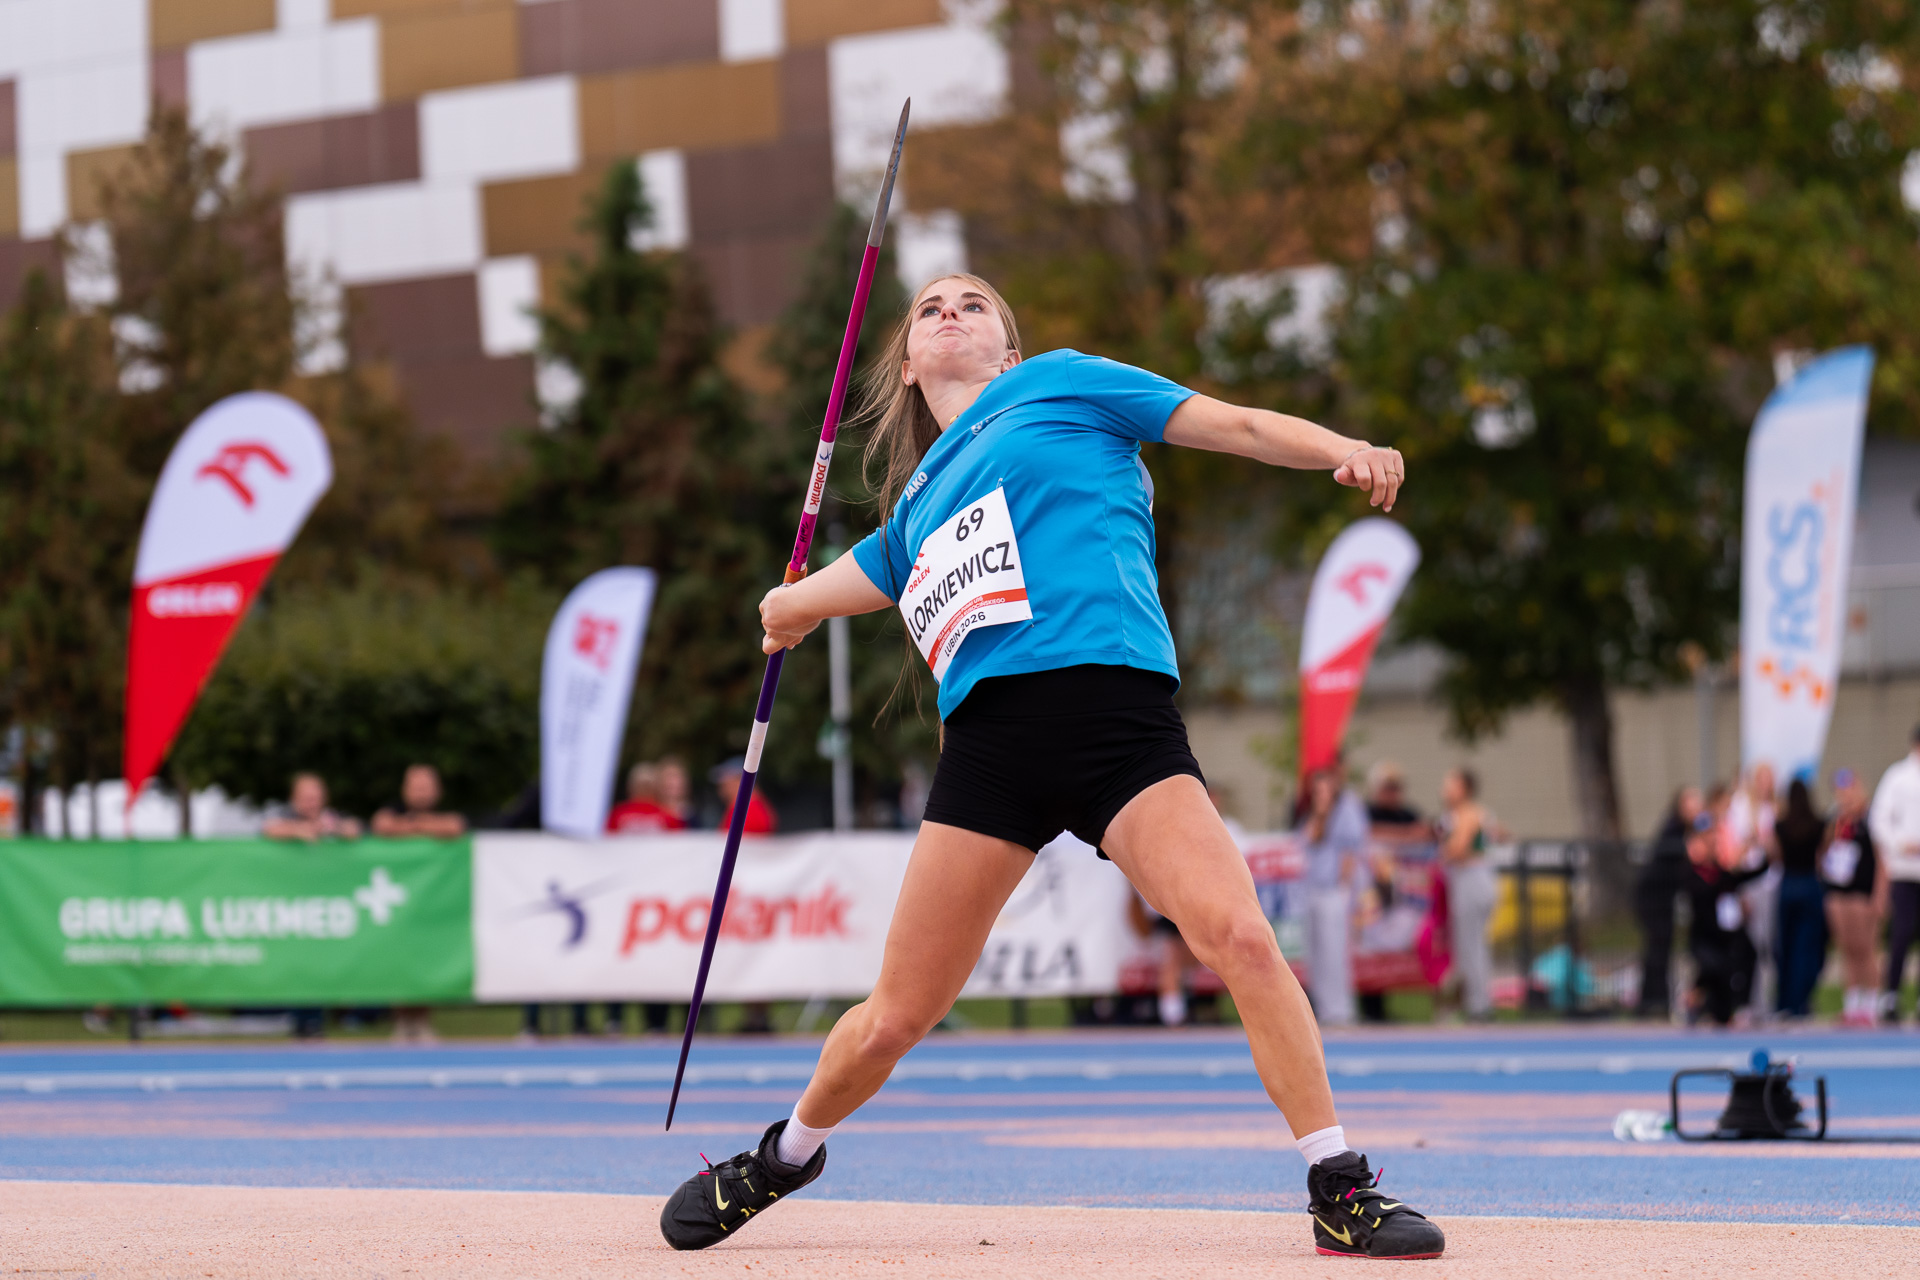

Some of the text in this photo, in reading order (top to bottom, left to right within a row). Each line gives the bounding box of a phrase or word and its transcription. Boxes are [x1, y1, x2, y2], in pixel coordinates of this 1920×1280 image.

[809, 461, 827, 507] polanik
[904, 471, 929, 501] JAKO
[955, 507, 985, 542] 69
[908, 566, 931, 593] ORLEN
[908, 541, 1015, 642] LORKIEWICZ
[944, 629, 961, 657] LUBIN
[960, 611, 986, 633] 2026
[59, 897, 358, 939] GRUPA LUXMED
[620, 884, 850, 954] polanik
